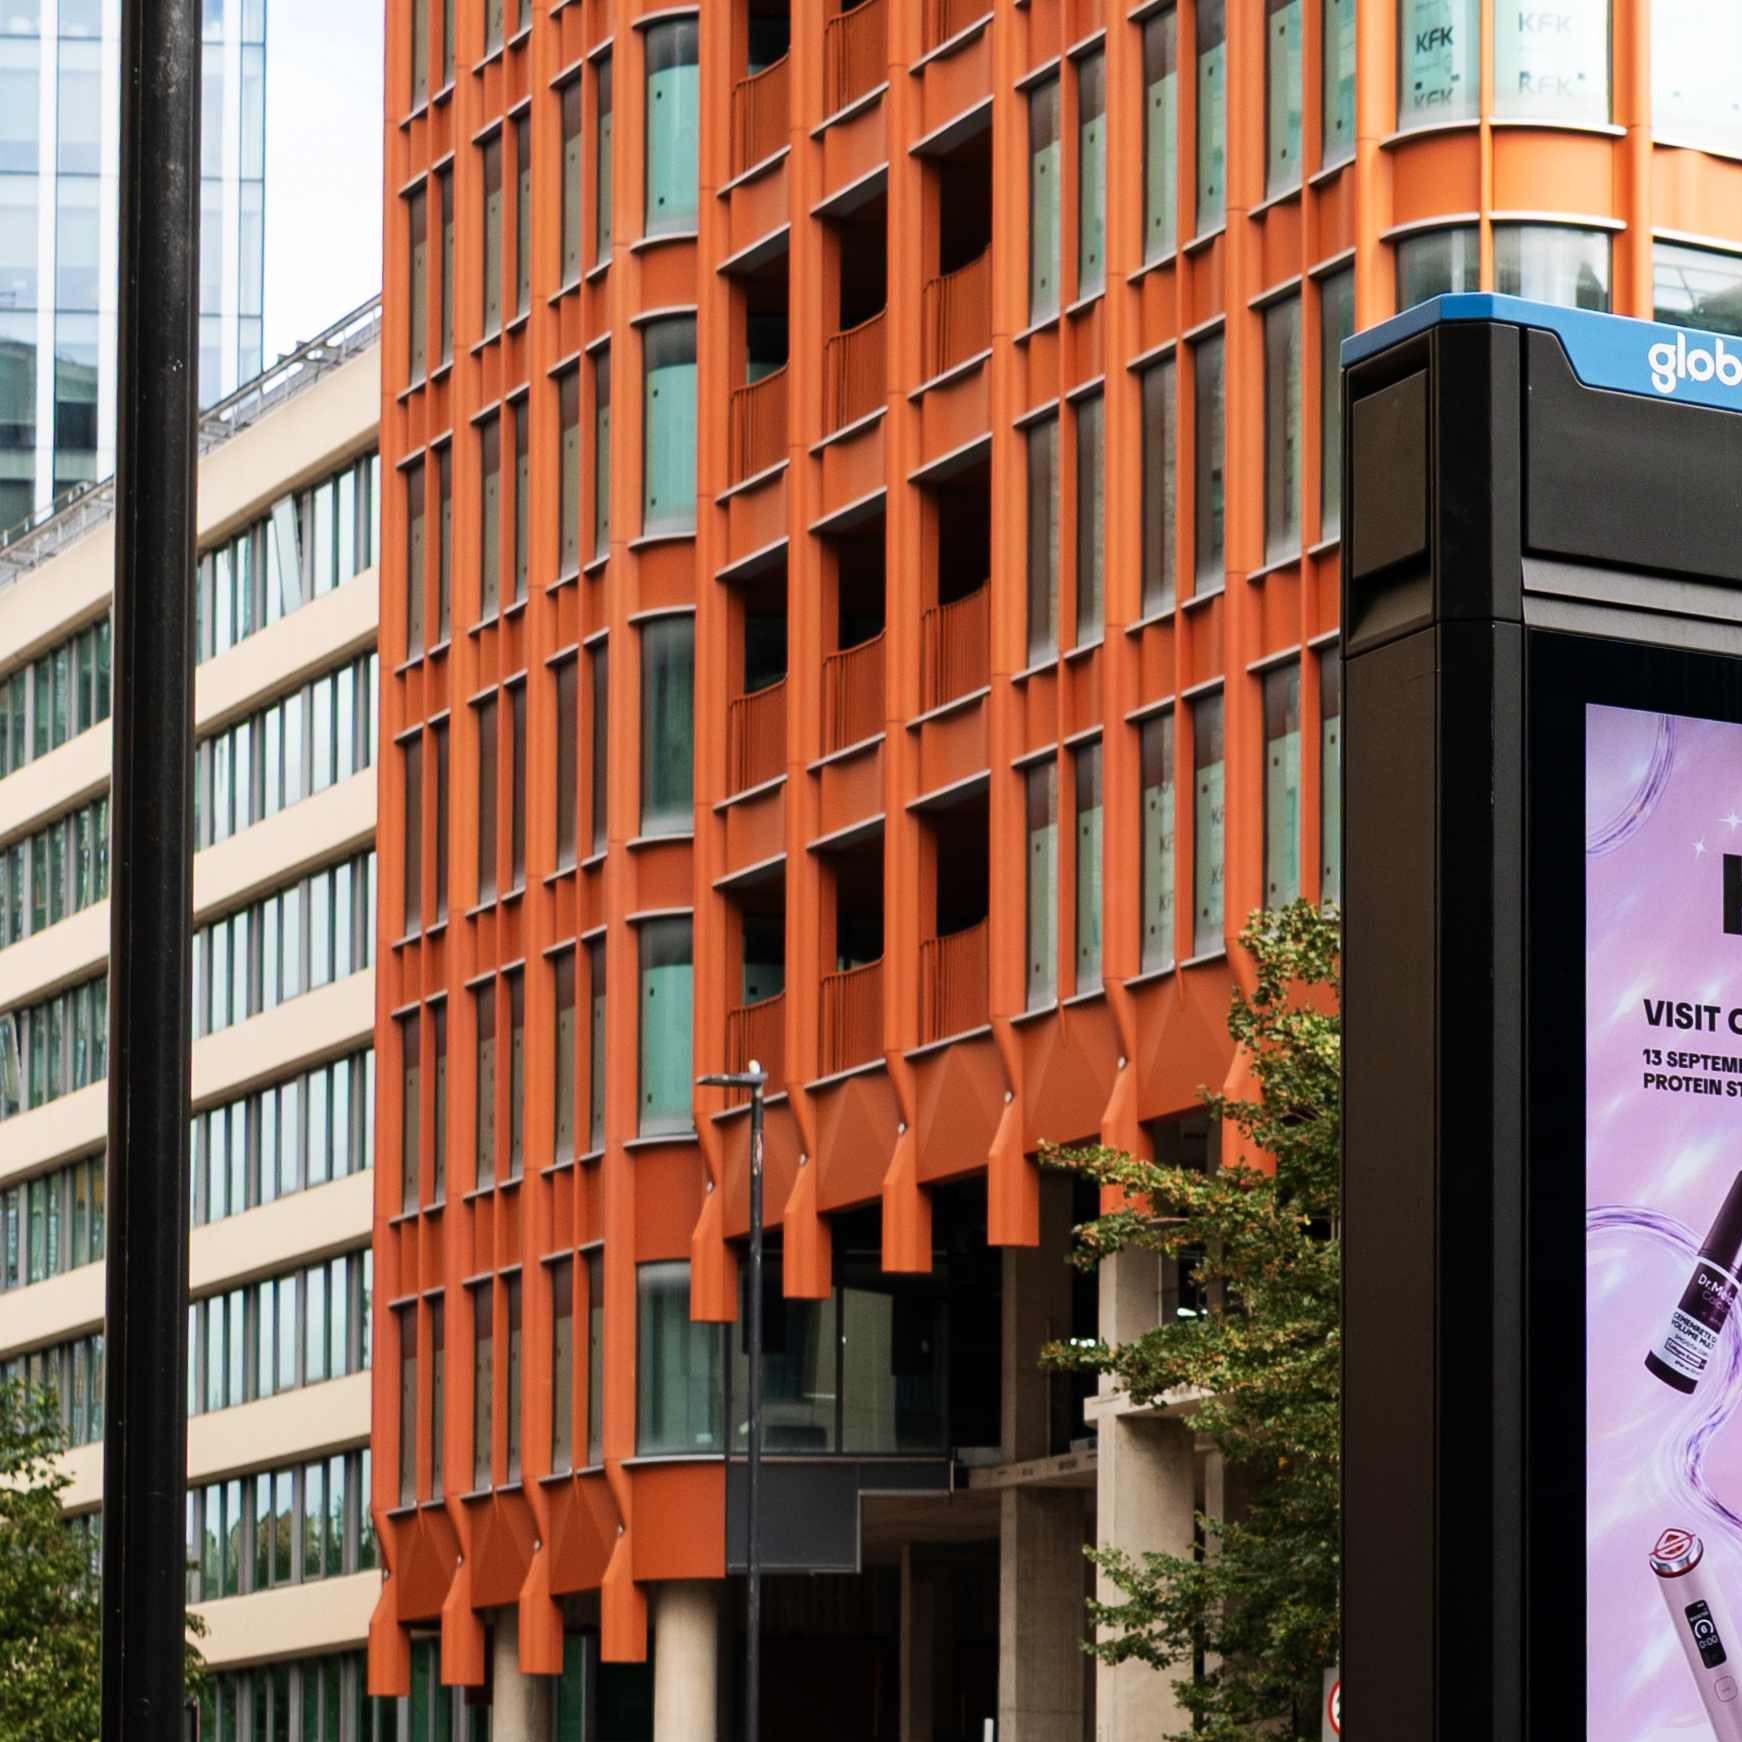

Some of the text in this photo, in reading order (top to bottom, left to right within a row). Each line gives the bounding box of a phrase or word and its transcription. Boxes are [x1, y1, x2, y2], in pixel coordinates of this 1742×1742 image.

[1416, 26, 1454, 54] KFK
[1644, 999, 1721, 1032] VISIT
[1643, 1049, 1662, 1066] 13
[1644, 1073, 1722, 1095] PROTEIN
